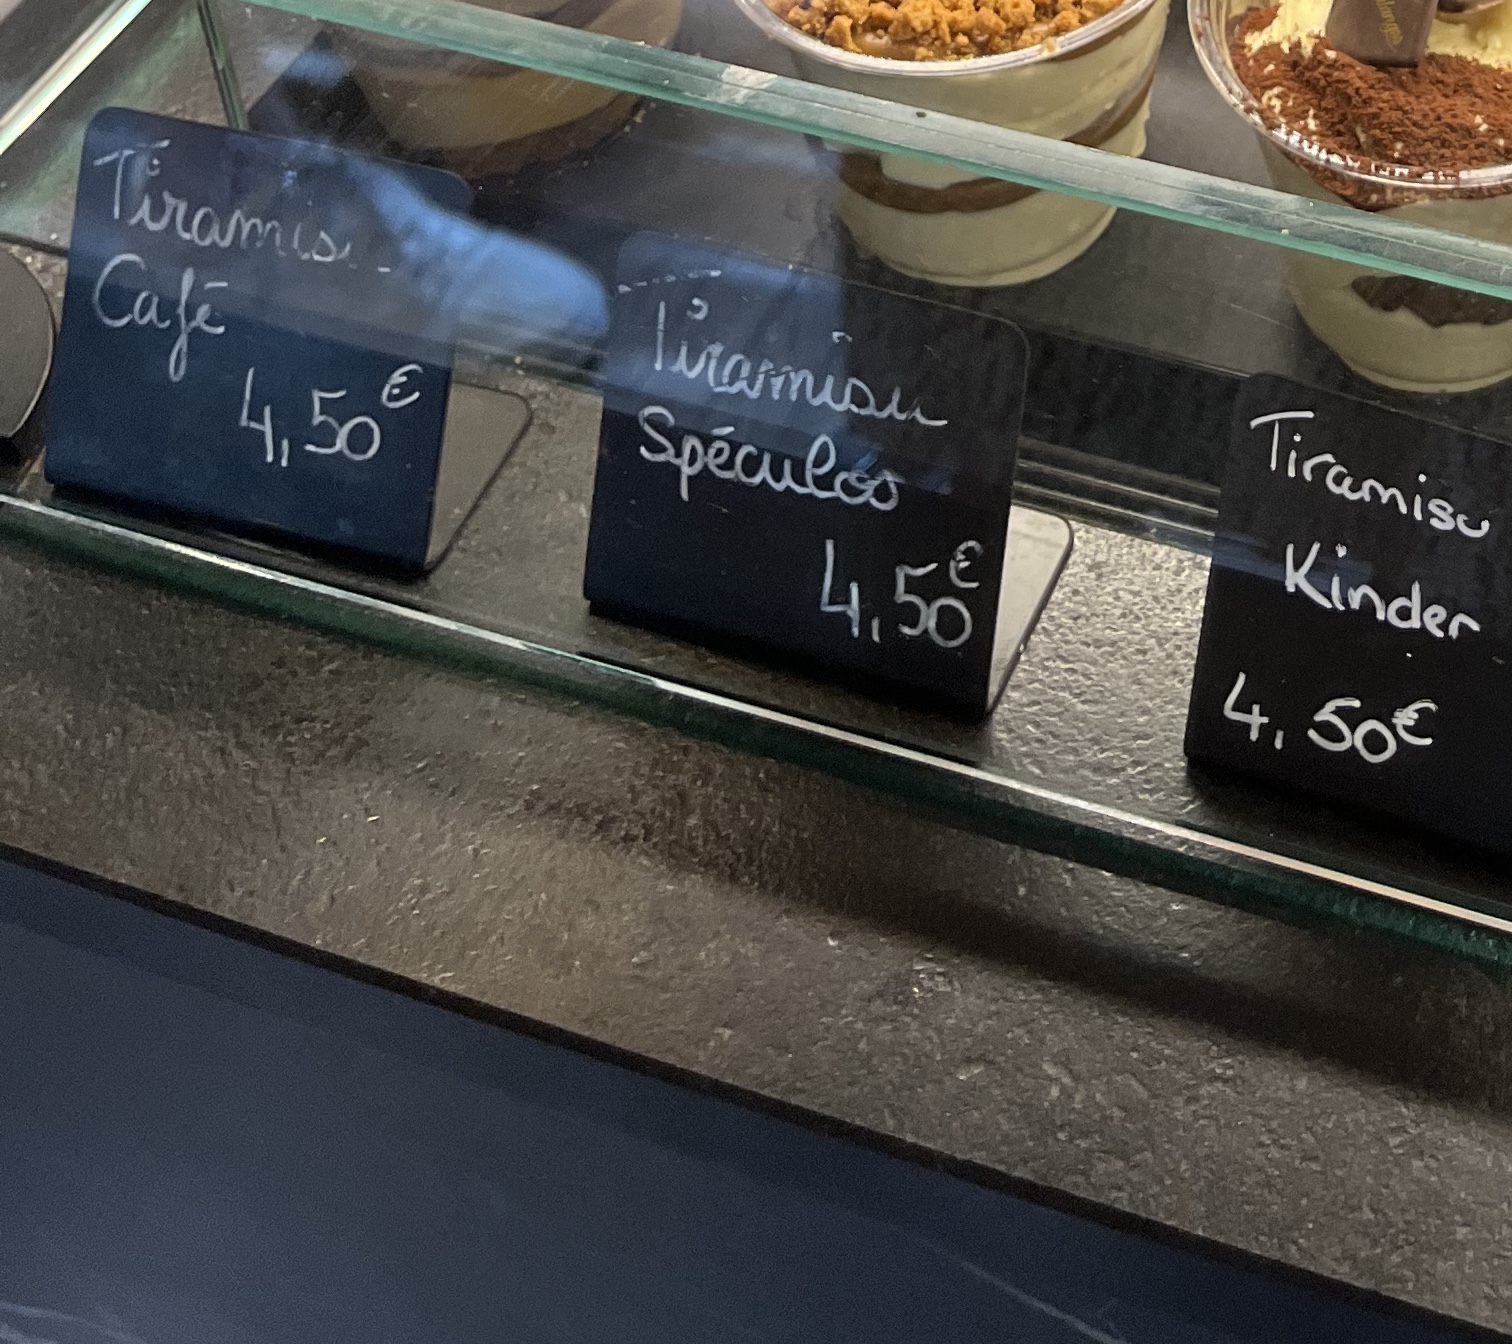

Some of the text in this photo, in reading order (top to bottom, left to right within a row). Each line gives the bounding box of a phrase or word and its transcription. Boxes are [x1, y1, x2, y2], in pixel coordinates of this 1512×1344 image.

[92, 252, 230, 382] Café
[618, 269, 949, 428] Tiramisu
[1249, 410, 1491, 538] Tiramisu
[1284, 541, 1481, 640] Kinder
